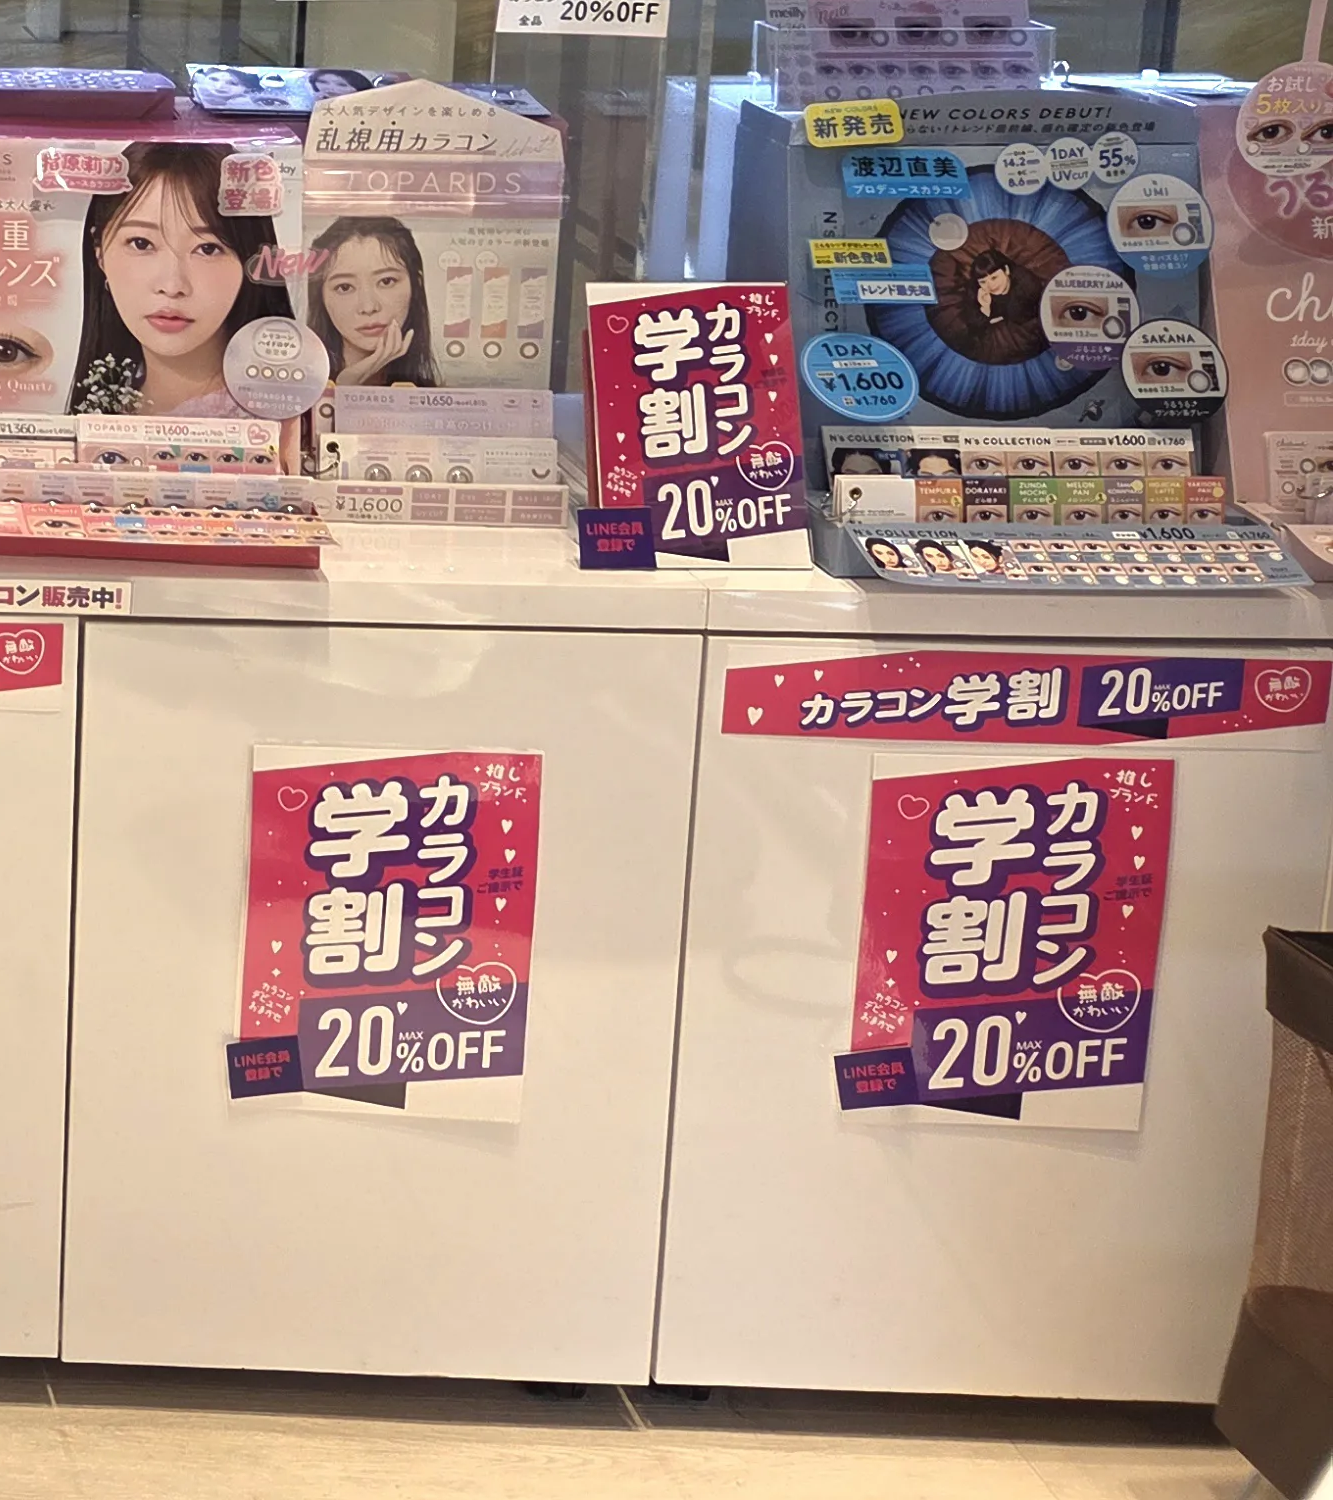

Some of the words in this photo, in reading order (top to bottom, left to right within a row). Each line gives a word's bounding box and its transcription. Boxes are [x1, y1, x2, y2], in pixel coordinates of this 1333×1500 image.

[560, 0, 661, 24] 20%OFF
[518, 15, 542, 27] 全品
[1266, 76, 1317, 94] お試し
[320, 105, 498, 117] 大人気デザインを楽しめる
[948, 108, 1030, 119] COLORS
[1039, 107, 1112, 119] DEBUT!
[1255, 93, 1322, 116] 5枚入り
[812, 114, 895, 138] 新発売
[315, 127, 498, 153] 乱視用カラコン
[1050, 147, 1085, 159] 1DAY
[1098, 149, 1136, 168] 55%
[225, 162, 277, 184] 新色
[851, 155, 958, 178] 渡辺直美
[345, 169, 524, 196] TOPARDS
[1052, 170, 1071, 183] UV
[223, 185, 280, 212] 登場!
[853, 184, 963, 196] プロデュースカラコン
[1142, 187, 1169, 198] UMI
[1141, 333, 1195, 344] SAKANA
[821, 343, 873, 357] 1DAY
[633, 307, 704, 459] 学割
[708, 302, 753, 456] カラコン
[344, 394, 395, 403] TOPARDS
[87, 422, 139, 432] TOPARDS
[847, 434, 915, 443] COLLECTION
[983, 437, 1051, 445] COLLECTION
[1072, 487, 1090, 495] PAN
[336, 497, 403, 513] ¥1,600
[656, 483, 793, 542] 20%OFF
[585, 521, 645, 535] LINE会員
[876, 529, 958, 538] COLLECTION
[596, 538, 636, 553] 登録で
[800, 667, 1062, 728] カラコン学割
[1096, 667, 1225, 717] 20%OFF
[305, 780, 411, 976] 学割
[411, 775, 470, 977] カラコン
[1034, 781, 1099, 983] カラコン
[921, 789, 1035, 985] 学割
[455, 975, 502, 996] 無敵
[1077, 983, 1126, 1004] 無敵
[451, 995, 507, 1010] かわいい
[1072, 1003, 1130, 1018] かわいい
[314, 1004, 507, 1078] 20%OFF
[233, 1049, 292, 1066] LINE会員
[927, 1015, 1128, 1089] 20%OFF
[842, 1064, 906, 1081] LINE会員
[856, 1078, 898, 1094] 登録で
